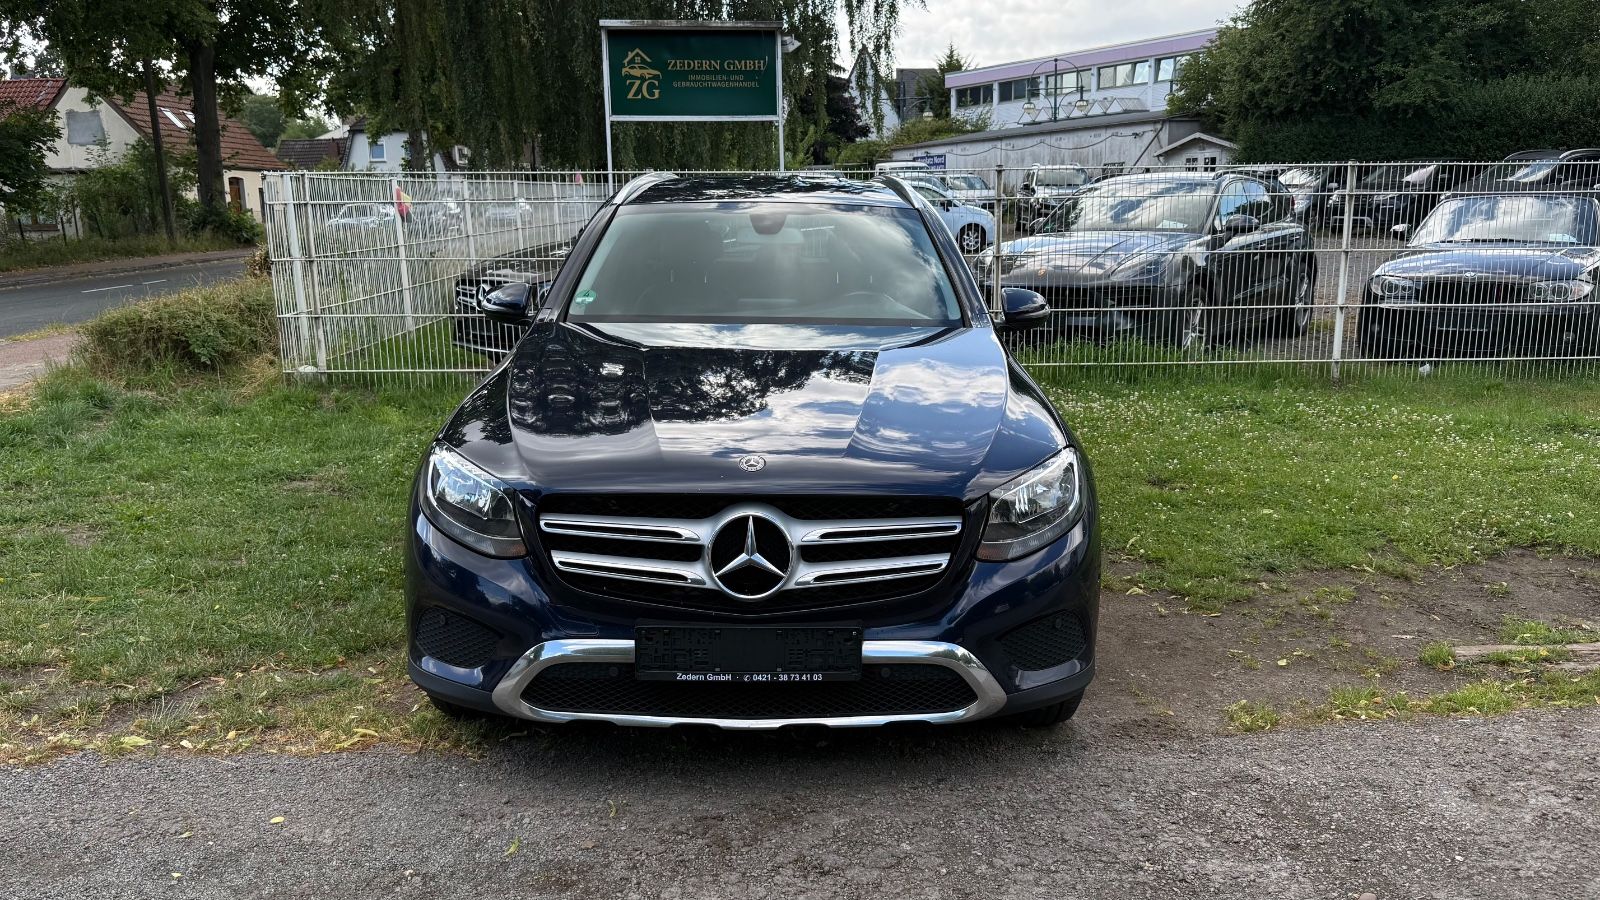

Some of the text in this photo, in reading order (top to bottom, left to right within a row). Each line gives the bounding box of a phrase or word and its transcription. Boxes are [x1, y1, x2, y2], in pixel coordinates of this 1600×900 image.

[667, 59, 765, 71] ZEDERN GMBH
[626, 79, 661, 99] ZG
[676, 672, 705, 681] Zedern
[707, 673, 732, 681] GmbH
